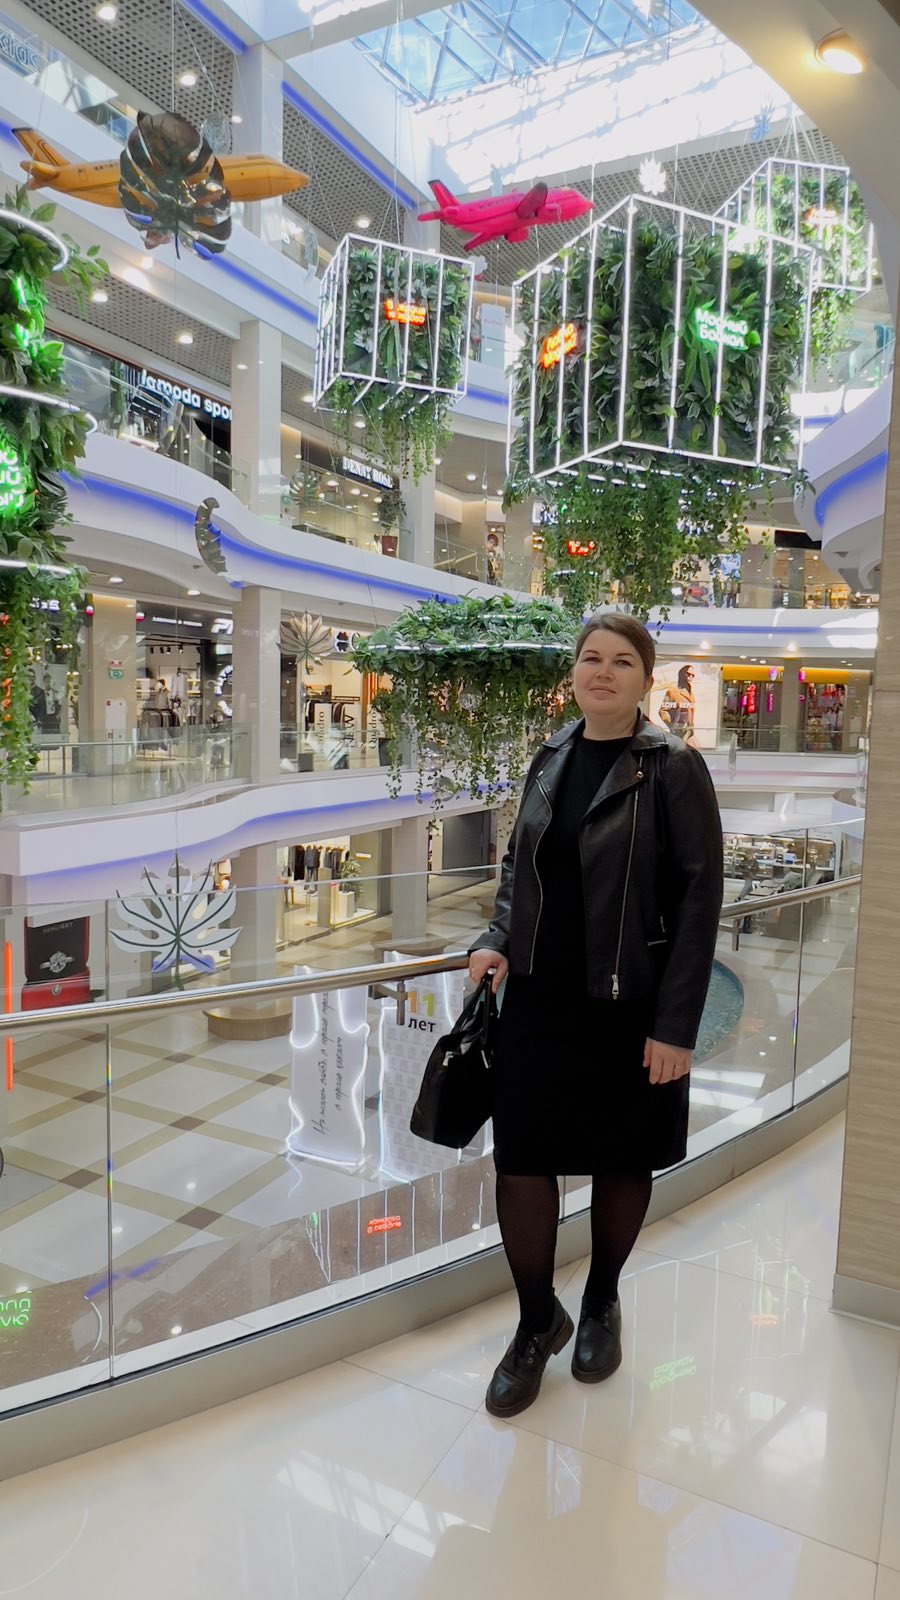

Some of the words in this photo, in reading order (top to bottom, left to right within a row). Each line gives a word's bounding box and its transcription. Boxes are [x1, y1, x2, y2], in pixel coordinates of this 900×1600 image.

[141, 369, 201, 408] lamoda
[342, 456, 371, 480] DENNY
[371, 468, 394, 489] ROSE
[344, 714, 354, 748] NEW
[408, 1018, 436, 1032] лет
